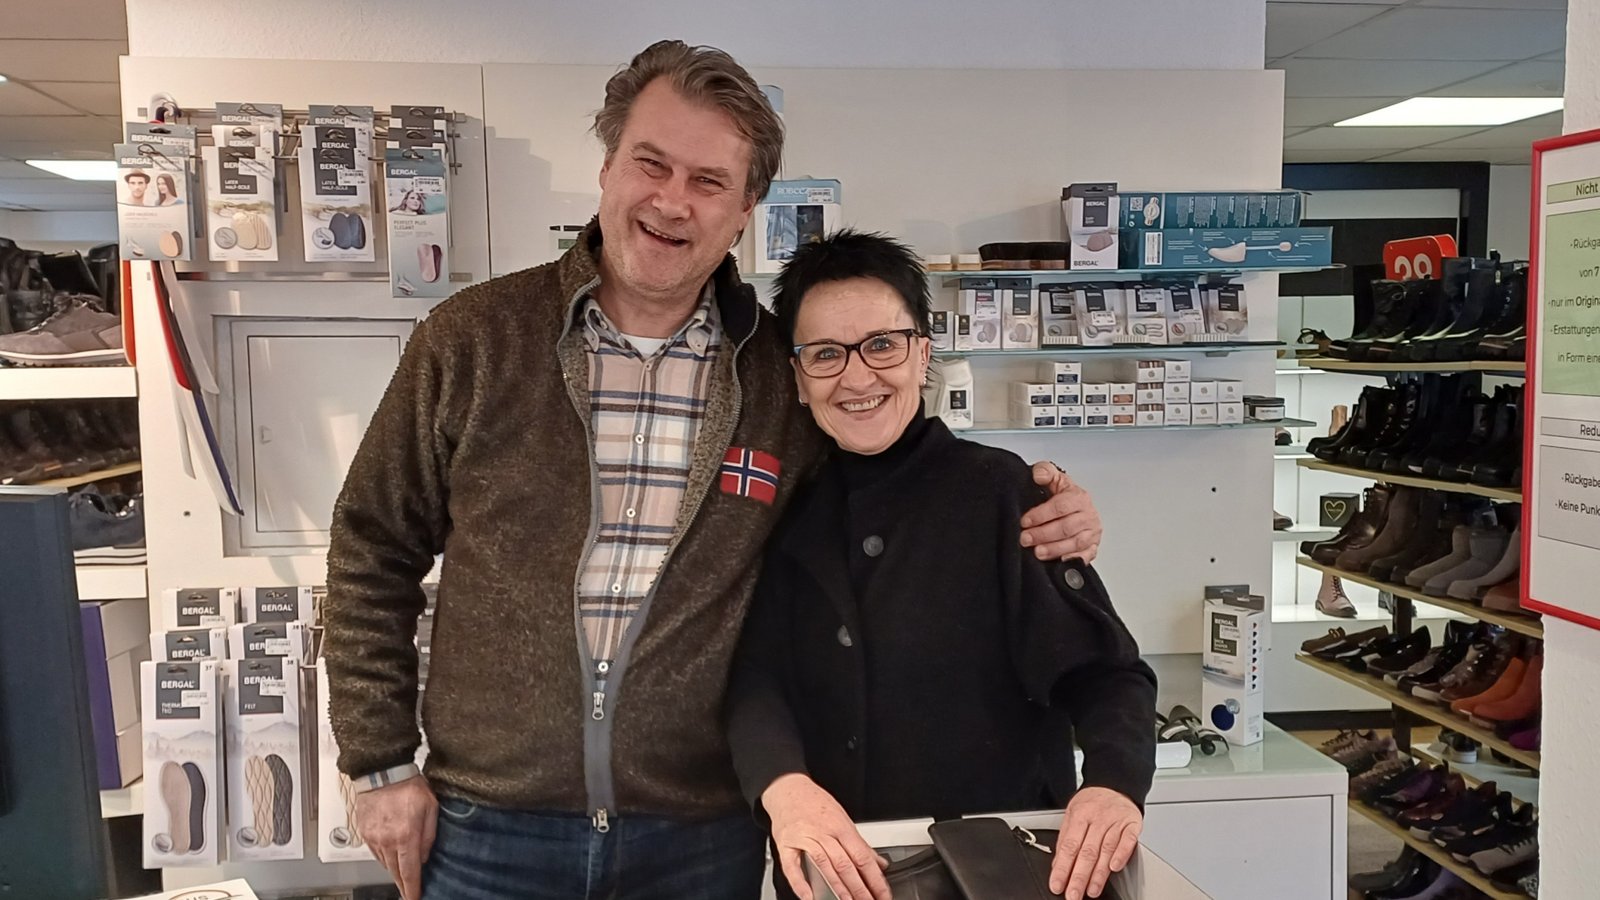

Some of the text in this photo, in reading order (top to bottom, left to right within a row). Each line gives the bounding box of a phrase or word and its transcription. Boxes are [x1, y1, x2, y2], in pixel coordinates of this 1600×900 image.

[221, 115, 251, 123] BERGAL
[314, 117, 345, 125] BERGAL
[131, 134, 163, 143] BERGAL
[121, 157, 153, 166] BERGAL
[391, 168, 418, 176] BERGAL
[1576, 182, 1599, 196] Nicht
[1579, 266, 1600, 278] von 7
[1551, 299, 1563, 307] nur
[1564, 298, 1575, 307] im
[1557, 352, 1565, 363] in
[1566, 352, 1586, 363] Form
[1558, 499, 1579, 513] Keine
[182, 606, 215, 615] BERGAL
[261, 604, 293, 612] BERGAL
[249, 642, 265, 651] BER
[172, 649, 205, 659] BERGAL
[161, 680, 194, 689] BERGAL
